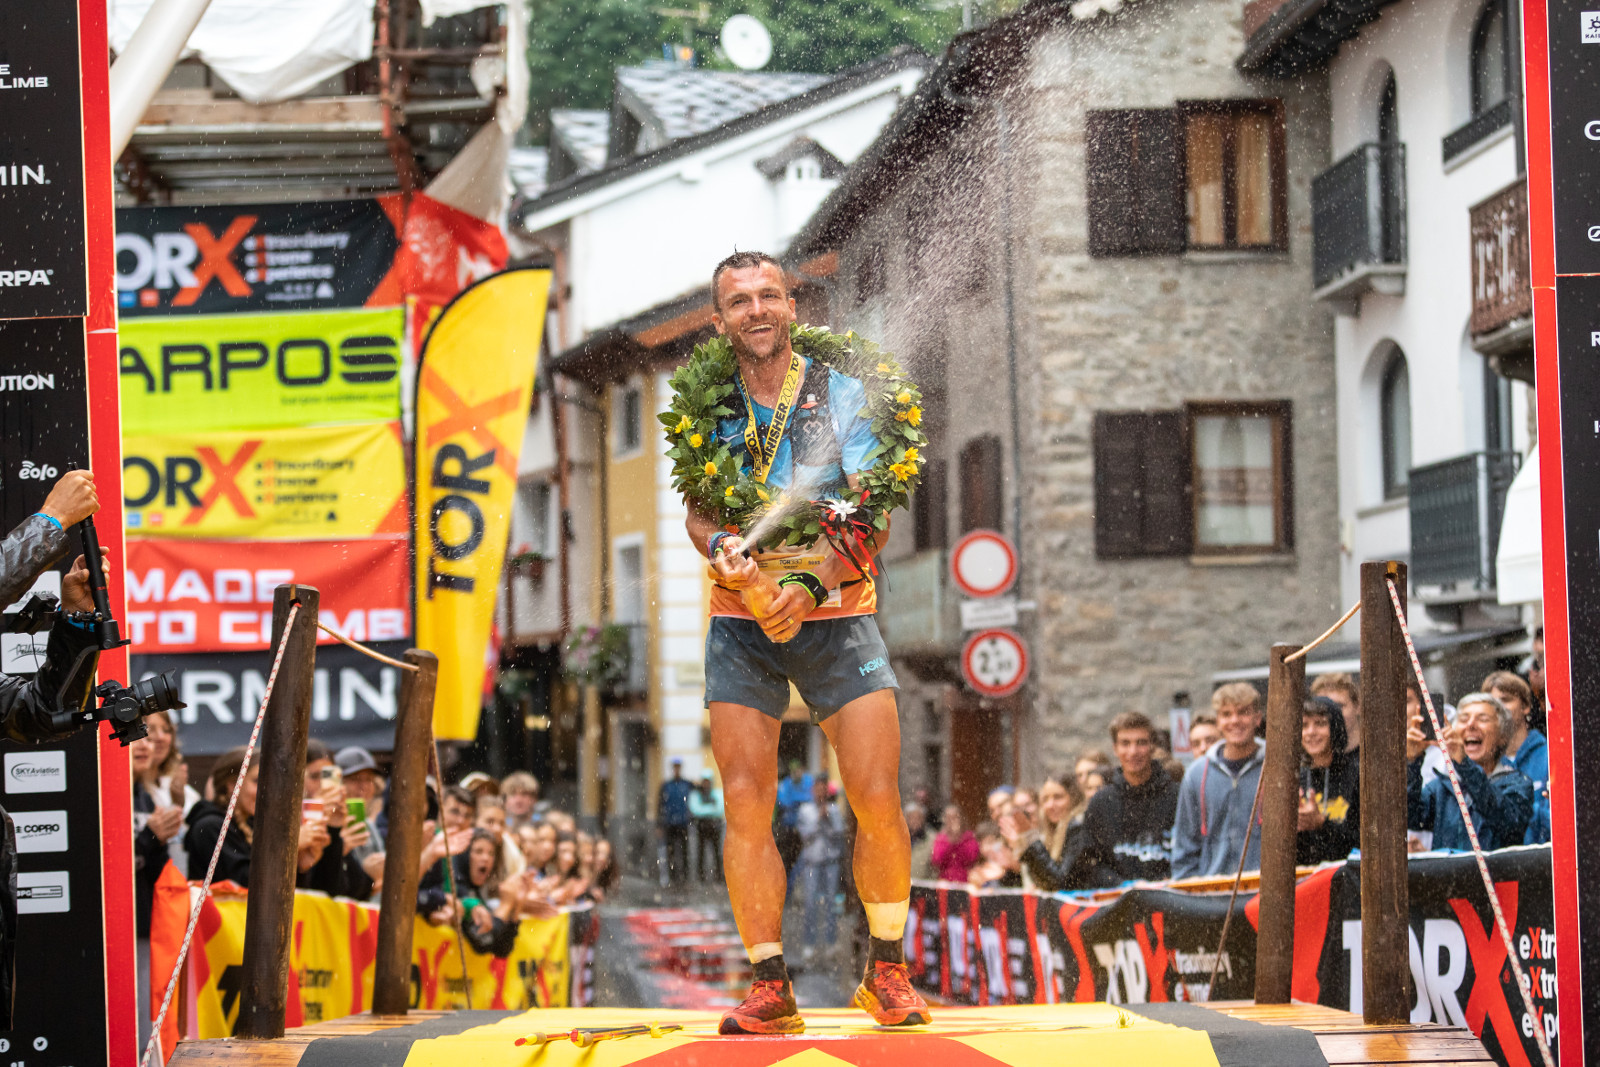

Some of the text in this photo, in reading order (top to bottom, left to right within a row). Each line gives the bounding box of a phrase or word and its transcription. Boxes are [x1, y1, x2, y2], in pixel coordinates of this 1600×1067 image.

[0, 76, 49, 89] LIMB
[763, 402, 789, 467] FINISHER
[18, 460, 58, 481] eolo
[426, 361, 524, 601] TORX
[127, 568, 295, 603] MADE
[128, 611, 197, 645] TO
[218, 608, 405, 644] CMB
[858, 656, 887, 677] HOKA
[24, 823, 60, 833] COPRO
